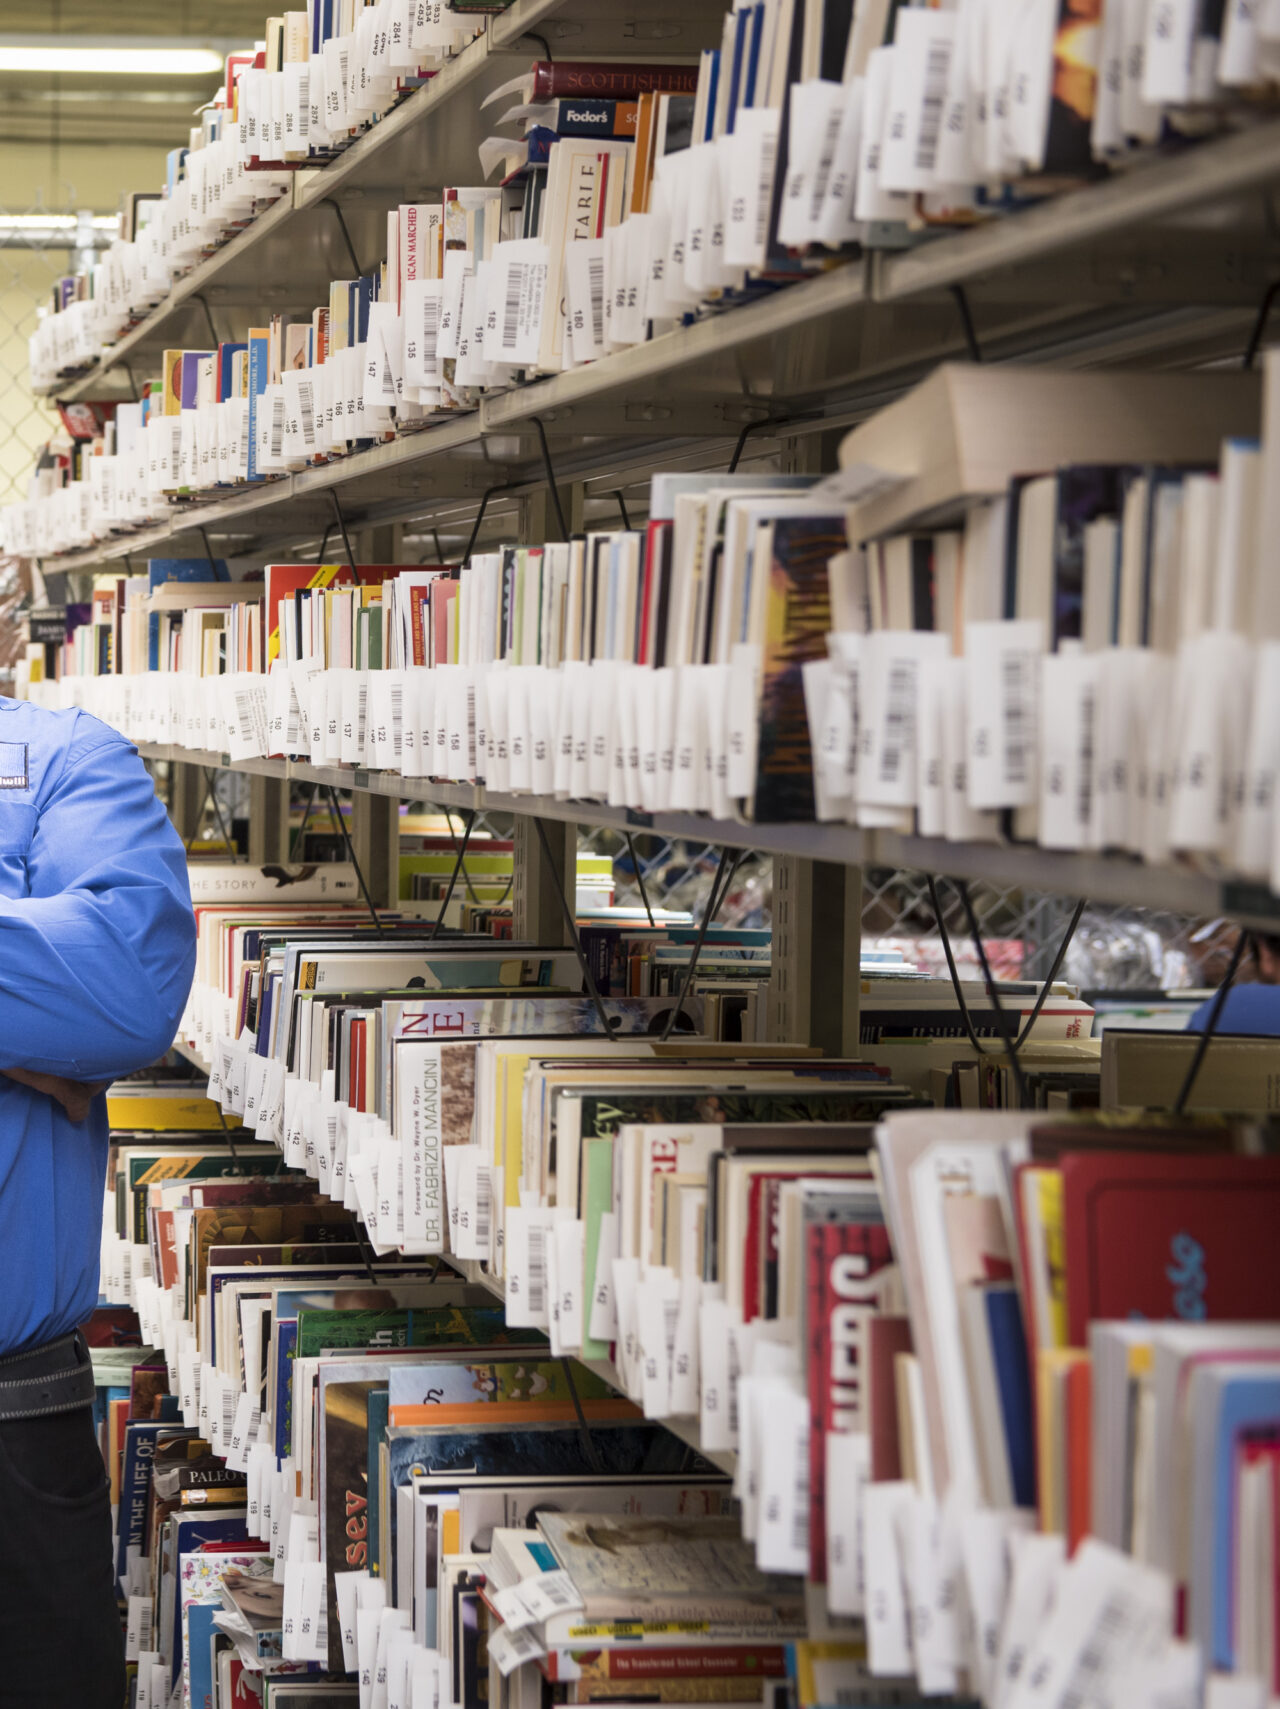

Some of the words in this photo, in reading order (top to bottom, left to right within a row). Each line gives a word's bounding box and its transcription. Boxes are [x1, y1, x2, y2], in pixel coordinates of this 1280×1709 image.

[393, 22, 402, 44] 2841
[567, 71, 663, 91] SCOTTISH
[330, 91, 339, 111] 2870
[285, 113, 294, 133] 2884
[566, 109, 608, 124] Fodor's
[274, 122, 282, 141] 2886
[407, 207, 418, 256] MARCHED
[673, 242, 683, 264] 147
[653, 259, 664, 280] 154
[442, 312, 451, 329] 196
[488, 311, 496, 329] 182
[574, 310, 583, 329] 180
[475, 326, 483, 343] 191
[408, 342, 416, 359] 135
[460, 339, 468, 357] 195
[368, 361, 376, 378] 147
[347, 400, 355, 415] 164
[290, 420, 298, 434] 184
[344, 723, 352, 738] 137
[378, 726, 386, 742] 122
[405, 731, 413, 748] 117
[451, 733, 459, 751] 158
[193, 881, 209, 890] HE
[215, 879, 257, 890] STORY
[413, 1086, 421, 1105] Dyer
[423, 1058, 438, 1130] MANCINI
[413, 1108, 420, 1118] W.
[292, 1131, 300, 1145] 142
[415, 1165, 421, 1174] by
[424, 1135, 439, 1209] FABRIZIO
[381, 1200, 389, 1216] 121
[367, 1212, 377, 1228] 122
[426, 1215, 440, 1242] DR.
[136, 1436, 154, 1457] OF
[232, 1437, 241, 1450] 201
[189, 1470, 234, 1484] PALEO
[632, 1607, 668, 1619] God's
[672, 1607, 707, 1618] Little
[710, 1607, 768, 1618] Wonders
[285, 1618, 293, 1634] 152
[302, 1618, 310, 1633] 150
[345, 1629, 353, 1645] 147
